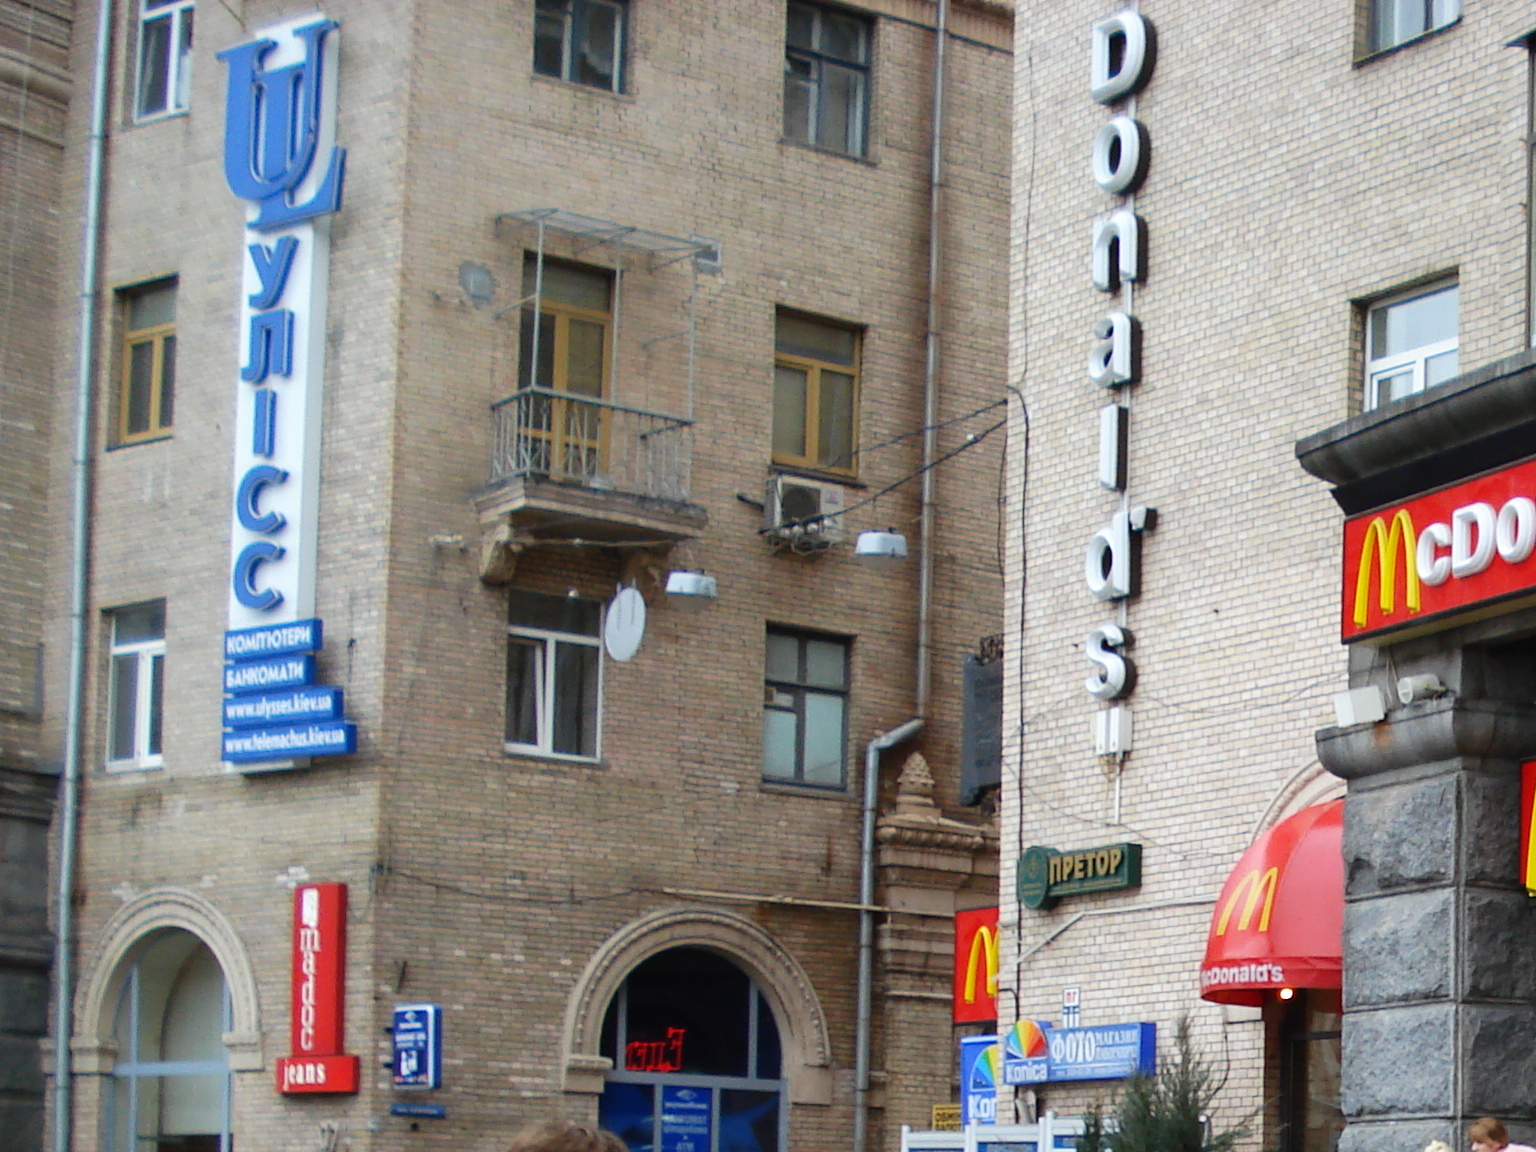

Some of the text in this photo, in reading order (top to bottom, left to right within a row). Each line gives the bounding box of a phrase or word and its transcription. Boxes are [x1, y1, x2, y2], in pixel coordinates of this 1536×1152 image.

[233, 235, 299, 612] УЛІСС
[226, 661, 304, 688] БАНКОМАТИ
[226, 693, 333, 719] www.ulysses.kiev.ua
[225, 726, 346, 753] www.telemachus.kiev.ua
[1049, 849, 1123, 885] ПРЕТОР
[1051, 1030, 1096, 1064] ФОТО
[283, 1060, 326, 1091] jeans
[1006, 1060, 1047, 1083] Konica
